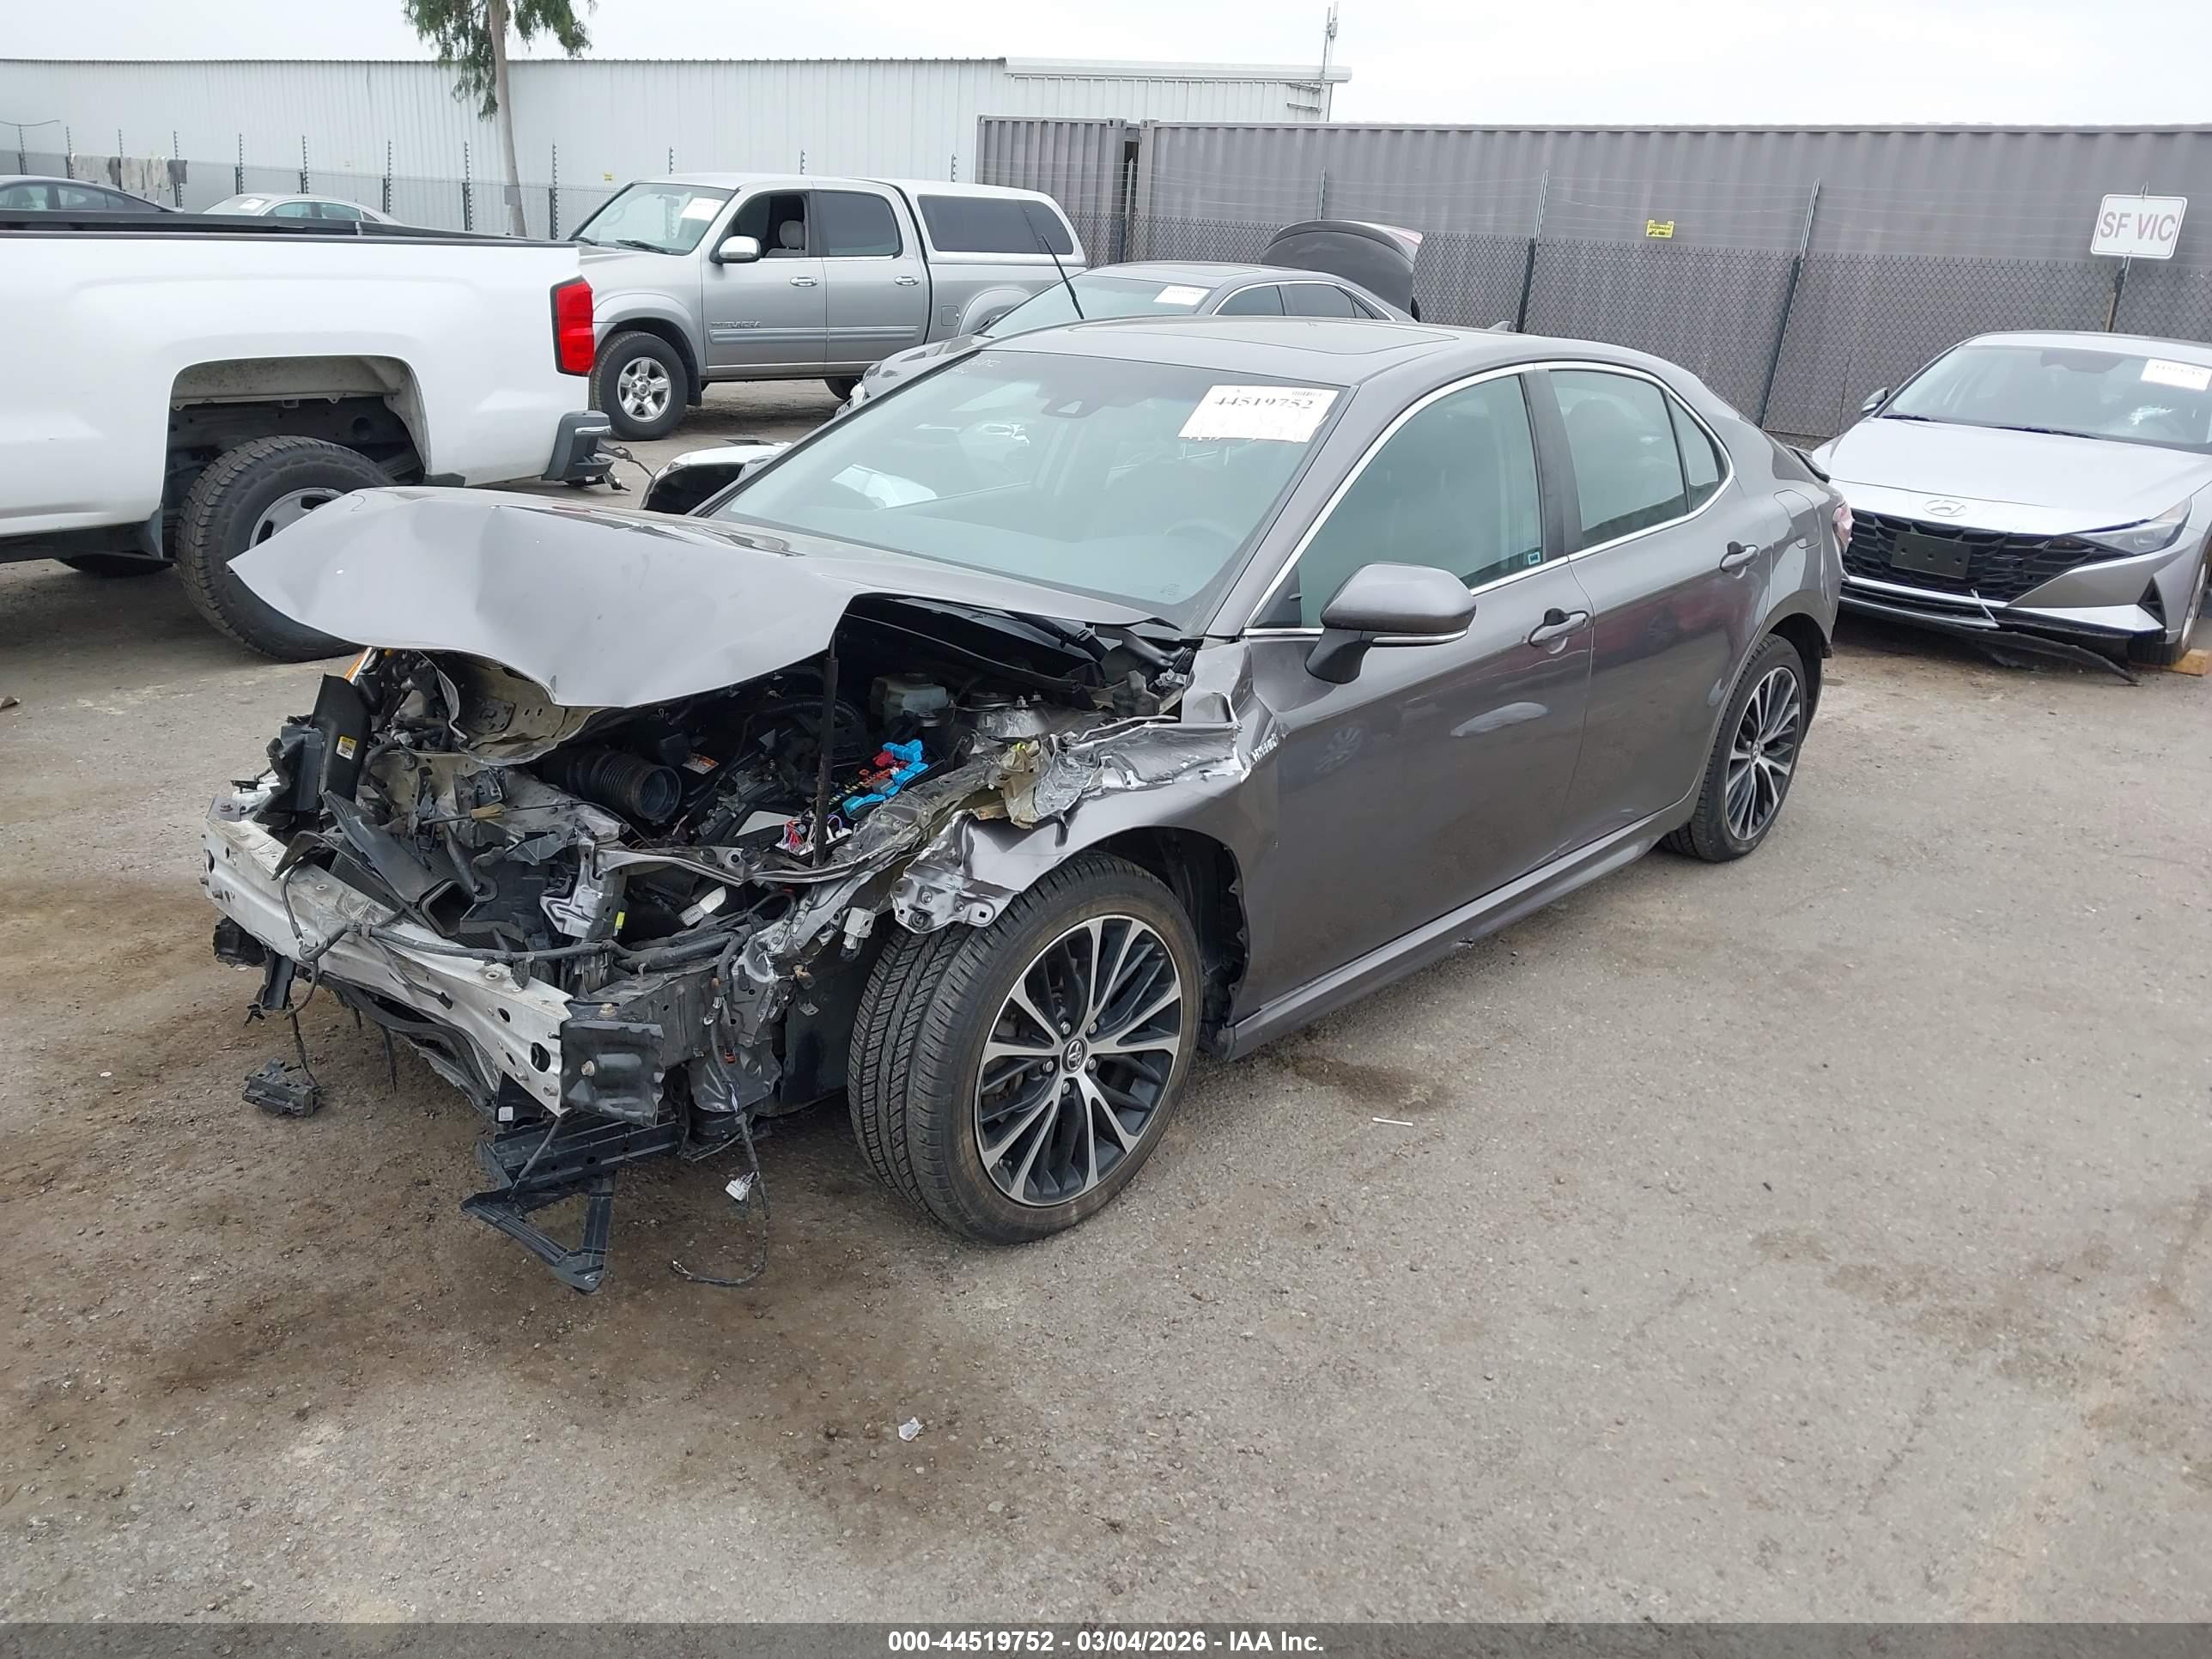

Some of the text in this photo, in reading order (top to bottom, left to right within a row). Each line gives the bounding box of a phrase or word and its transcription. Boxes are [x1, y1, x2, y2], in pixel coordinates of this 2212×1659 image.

[2100, 211, 2176, 241] SF VIC
[1214, 396, 1315, 410] 44519752
